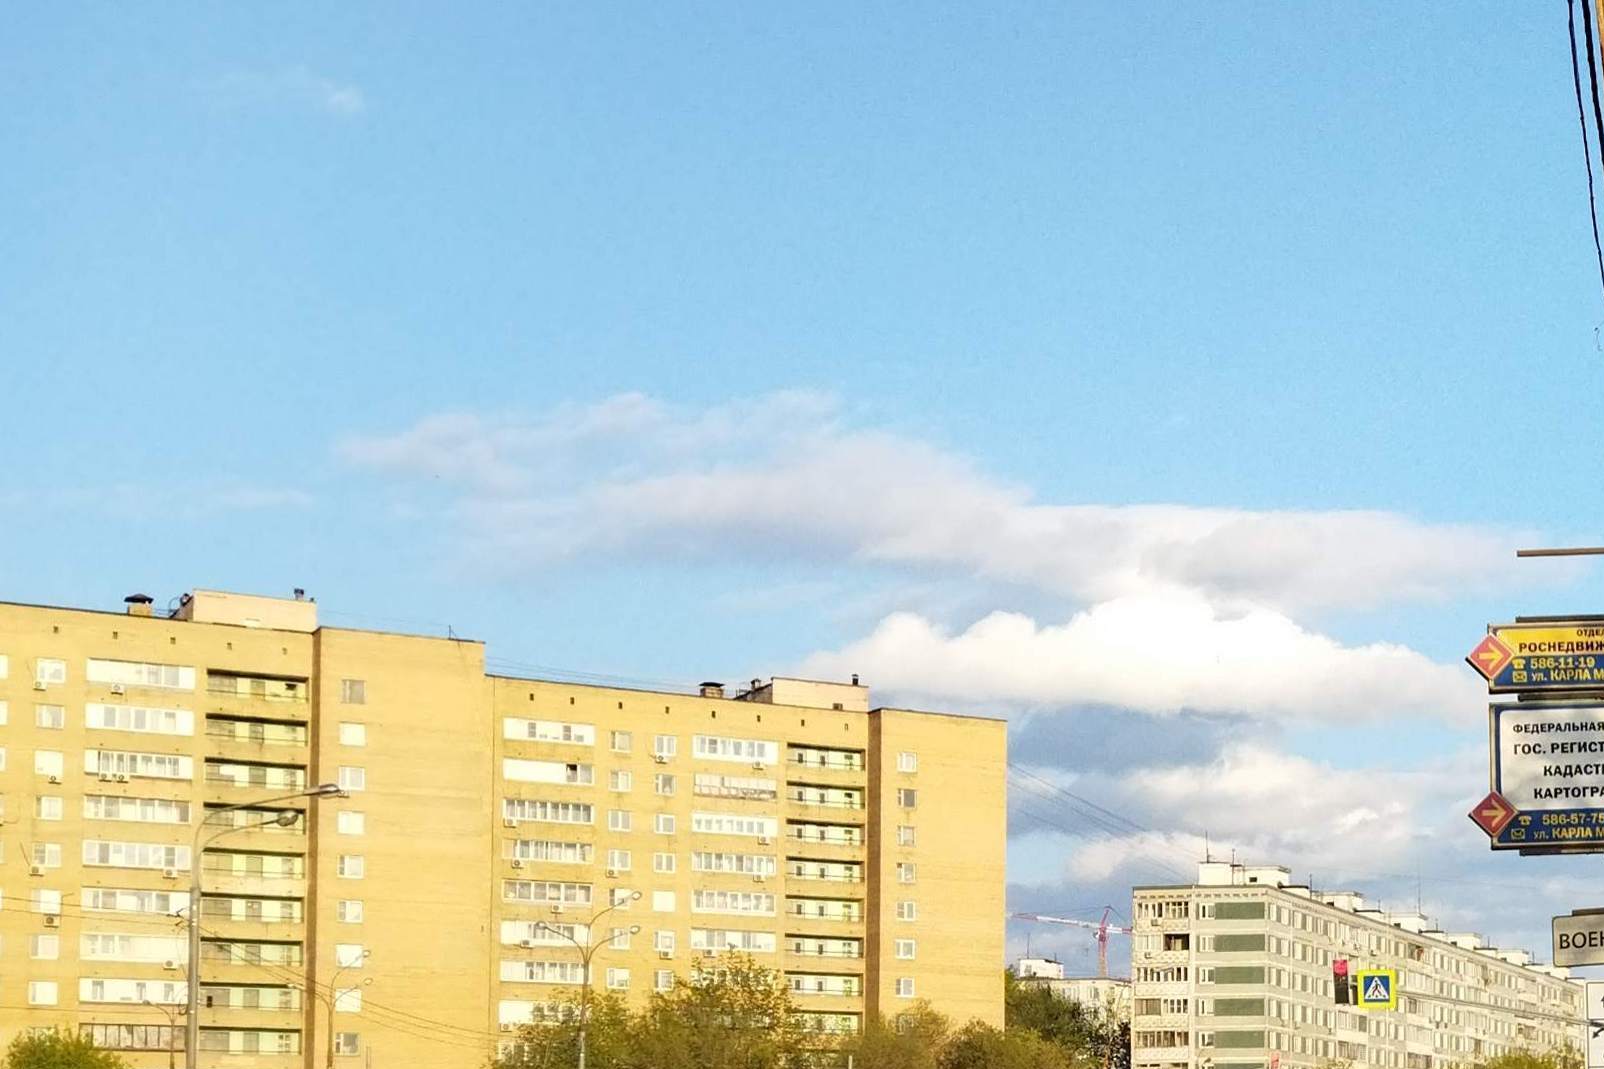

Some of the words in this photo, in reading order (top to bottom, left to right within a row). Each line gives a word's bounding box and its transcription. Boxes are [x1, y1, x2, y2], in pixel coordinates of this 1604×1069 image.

[1550, 668, 1592, 681] КАРЛА
[1512, 721, 1604, 735] ФЕДЕРАЛЬНАЯ
[1513, 743, 1547, 755] ГОС.
[1552, 827, 1592, 839] КАРЛА
